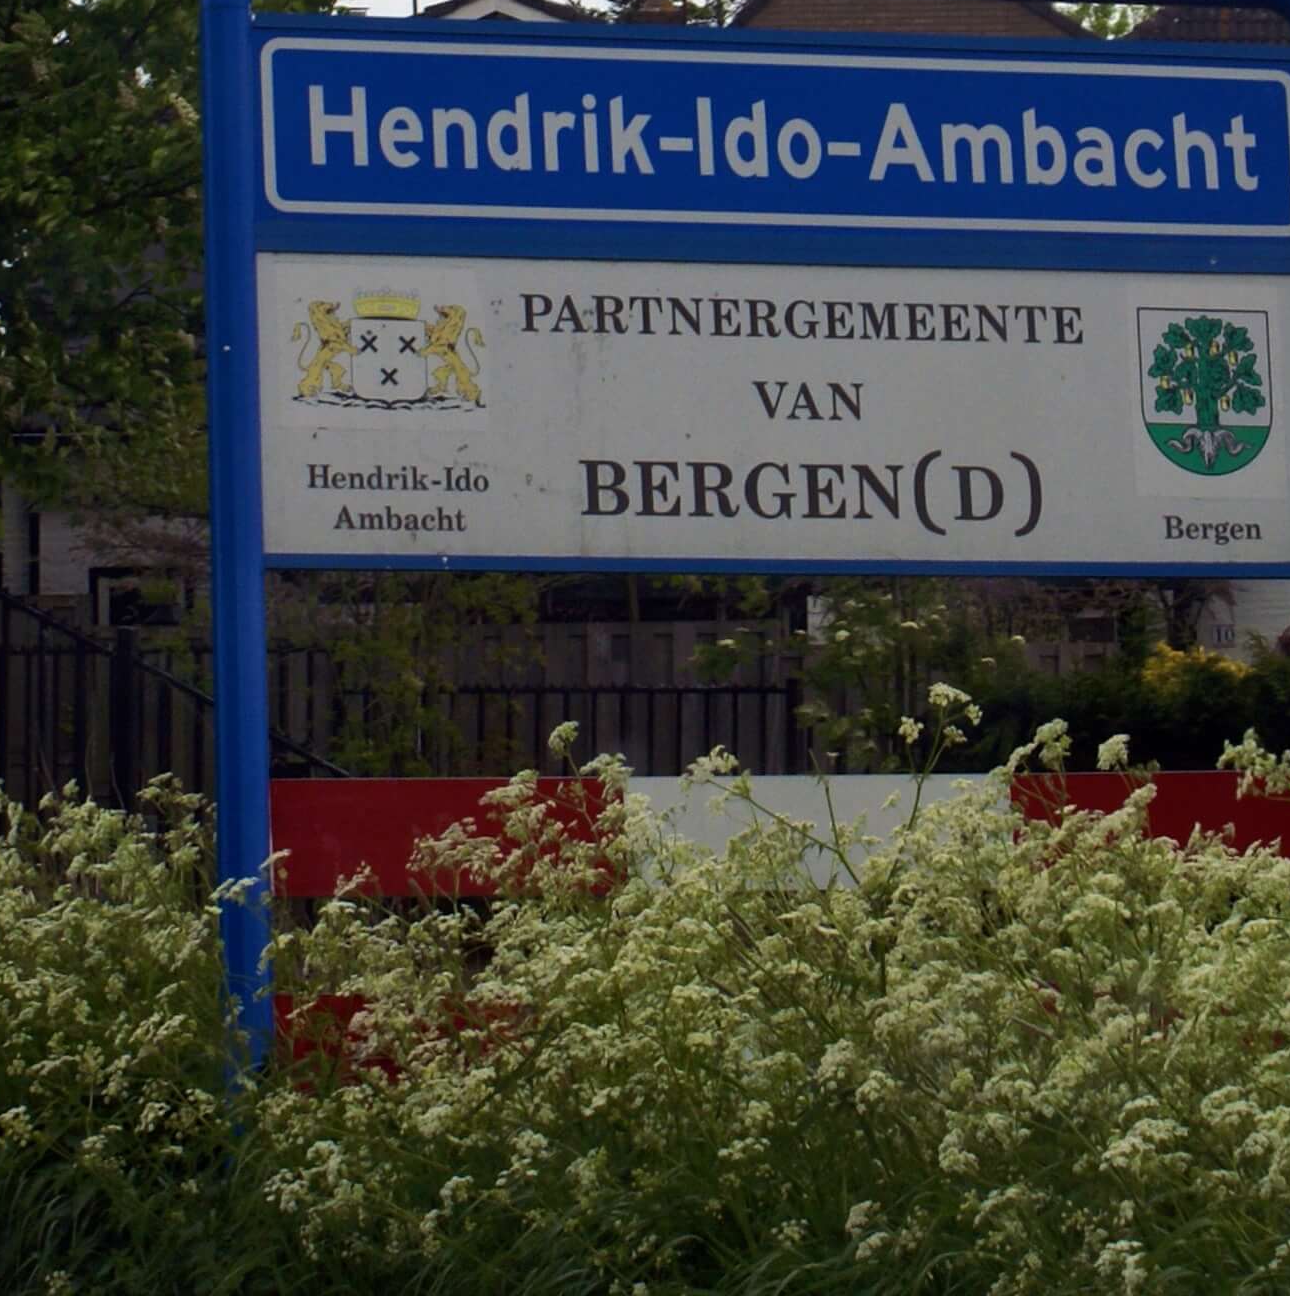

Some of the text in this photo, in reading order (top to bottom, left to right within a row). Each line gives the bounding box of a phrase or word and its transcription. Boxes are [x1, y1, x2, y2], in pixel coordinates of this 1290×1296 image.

[308, 84, 1260, 192] Hendrik-Ido-Ambacht
[519, 293, 1085, 345] PARTNERGEMEENTE
[751, 380, 865, 421] VAN
[306, 463, 491, 493] Hendrik-Ido
[578, 449, 1043, 537] BERGEN(D)
[332, 505, 468, 532] Ambacht
[1162, 514, 1263, 546] Bergen
